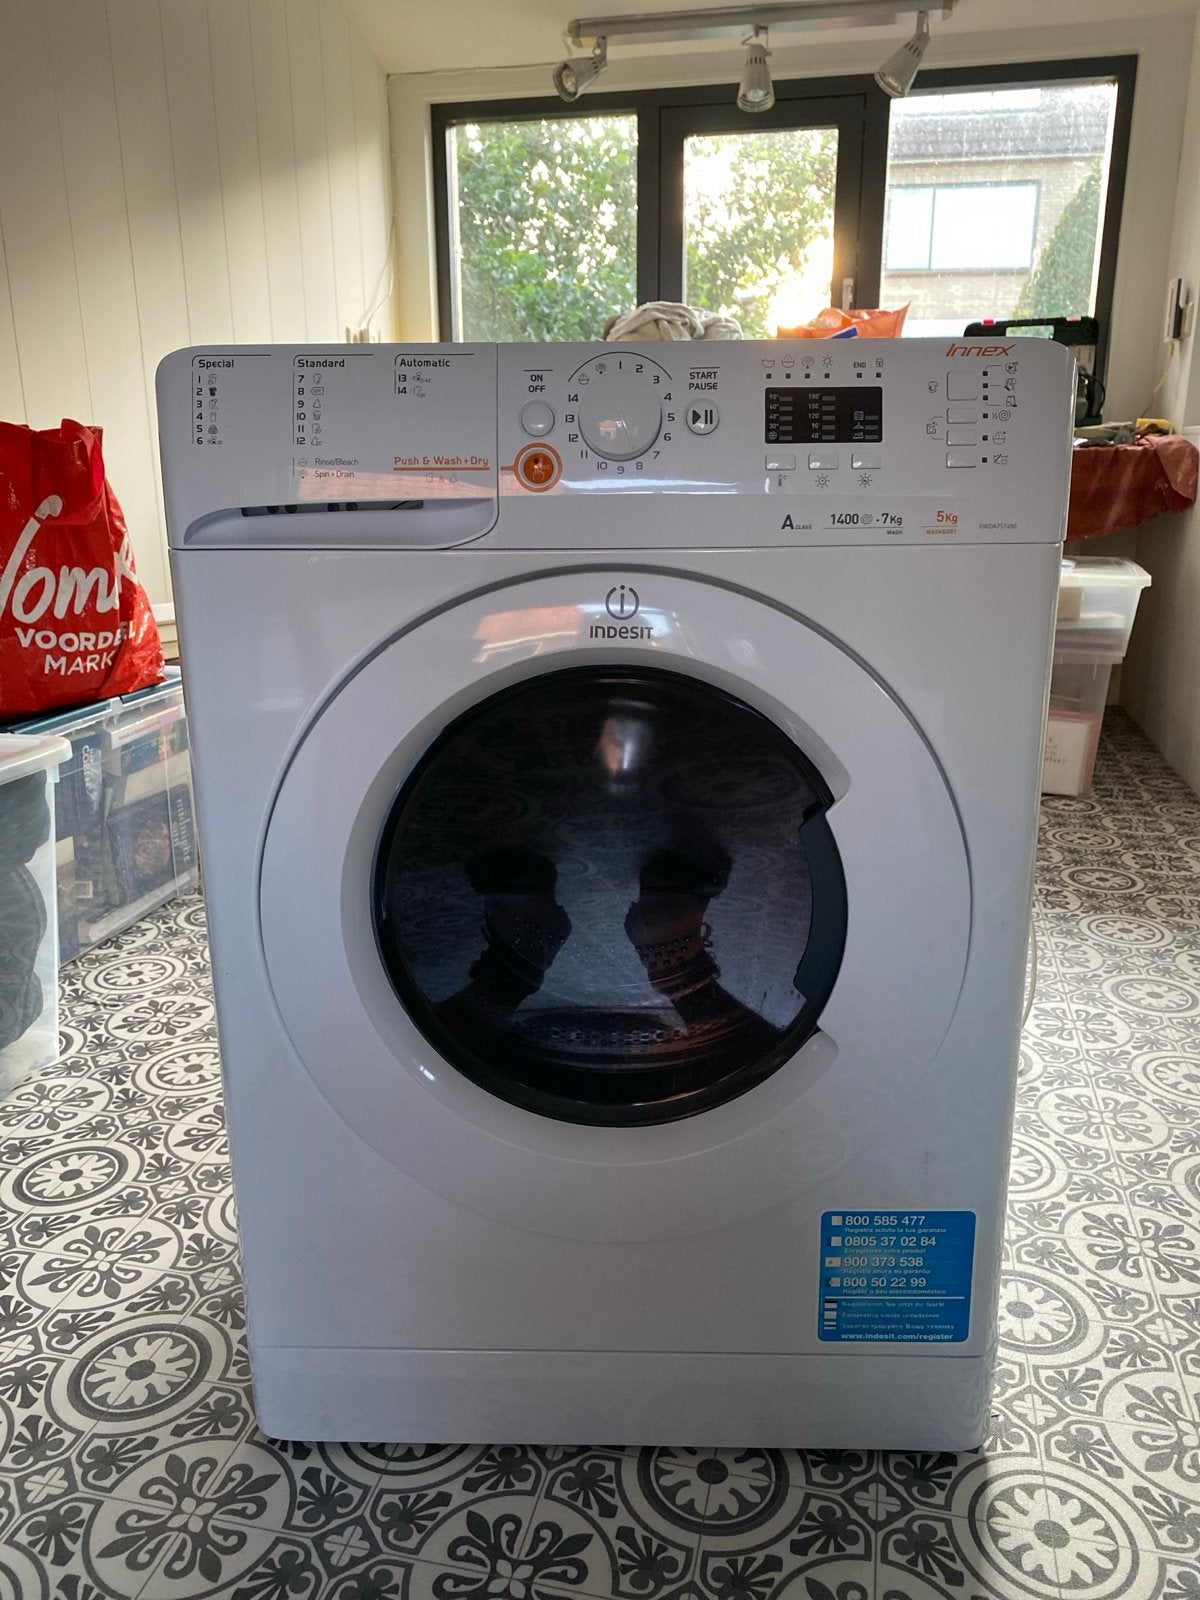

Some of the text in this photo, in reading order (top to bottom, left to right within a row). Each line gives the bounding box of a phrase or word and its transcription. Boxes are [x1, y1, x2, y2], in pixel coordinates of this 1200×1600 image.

[946, 344, 1016, 356] Innex
[198, 359, 234, 370] Special
[298, 358, 345, 368] Standard
[400, 358, 450, 368] Automatic
[636, 364, 643, 373] 2
[298, 375, 304, 383] 7
[399, 374, 406, 382] 13
[530, 374, 543, 382] ON
[653, 376, 660, 384] 3
[196, 388, 203, 396] 2
[398, 386, 407, 394] 14
[528, 385, 546, 393] OFF
[568, 394, 579, 402] 14
[664, 392, 672, 401] 4
[196, 400, 203, 408] 3
[298, 400, 304, 408] 9
[297, 412, 306, 420] 10
[565, 414, 575, 423] 13
[667, 413, 675, 422] 5
[196, 424, 203, 433] 5
[298, 425, 304, 433] 11
[196, 436, 203, 445] 6
[297, 436, 306, 445] 12
[568, 434, 579, 442] 12
[664, 433, 671, 442] 6
[580, 450, 588, 458] 11
[653, 451, 660, 459] 7
[315, 458, 359, 466] Rinse/Bleach
[394, 456, 420, 465] Push
[423, 456, 430, 465] &
[597, 462, 608, 470] 10
[617, 466, 624, 474] 9
[636, 462, 644, 470] 8
[315, 470, 329, 479] Spin
[781, 514, 794, 529] A
[830, 514, 859, 524] 1400
[845, 1216, 926, 1226] 800 585 477
[845, 1236, 936, 1246] 0805 37 02 84
[843, 1257, 923, 1267] 900 373 538
[843, 1278, 926, 1287] 800 50 22 99
